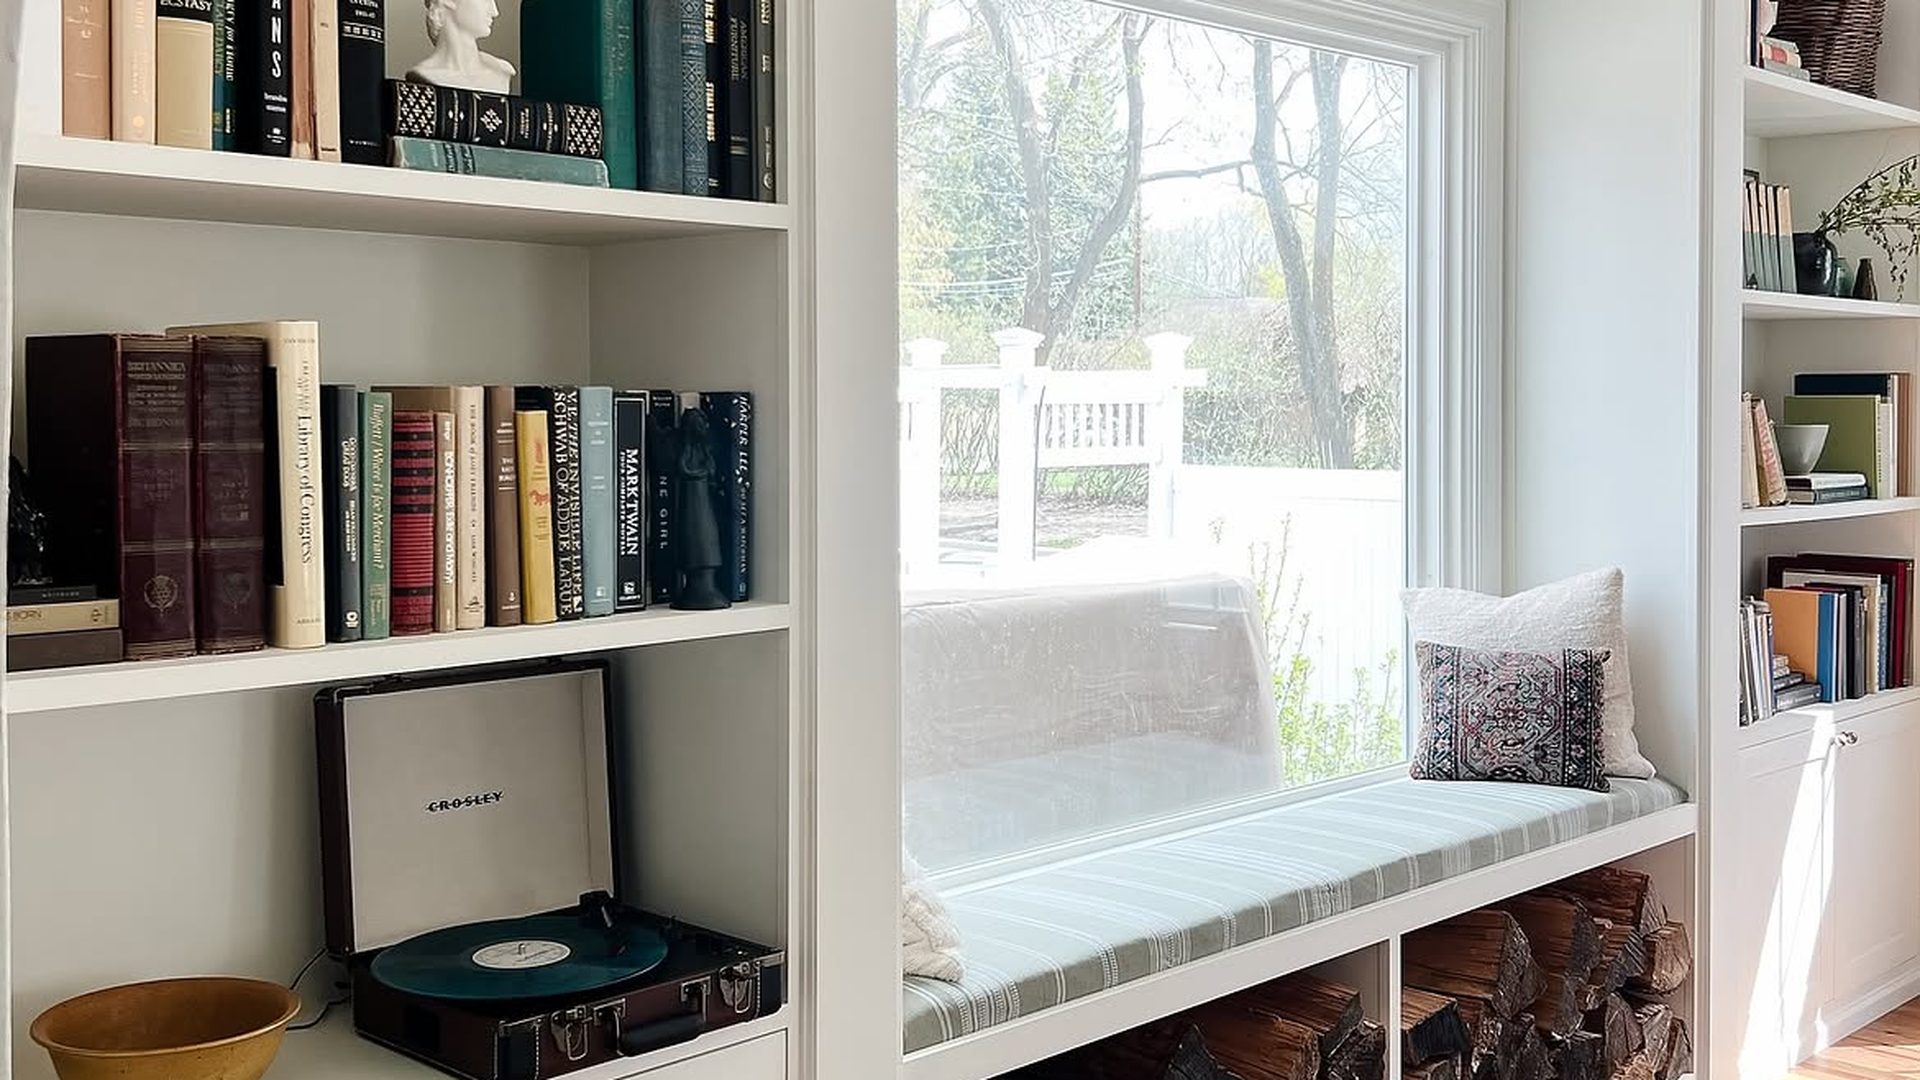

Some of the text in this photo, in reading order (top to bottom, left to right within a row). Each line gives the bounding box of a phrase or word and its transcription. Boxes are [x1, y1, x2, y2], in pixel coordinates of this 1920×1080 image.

[160, 0, 212, 11] ECSTASY
[729, 17, 740, 80] FURNITURE
[296, 415, 313, 472] Library
[369, 404, 385, 439] Buffett
[554, 391, 569, 463] SCHWAB
[739, 396, 751, 471] HARPER LEE
[299, 475, 315, 493] of
[372, 448, 384, 481] Where
[298, 493, 316, 565] Congress
[567, 423, 582, 594] THE INVISIBLE LIFE
[626, 448, 639, 555] MARK TWAIN
[659, 508, 669, 549] GIRL
[372, 512, 385, 569] Merchant?
[444, 533, 455, 552] and
[555, 467, 573, 615] OF ADDIE LARUE
[426, 791, 504, 812] CROSLEY
